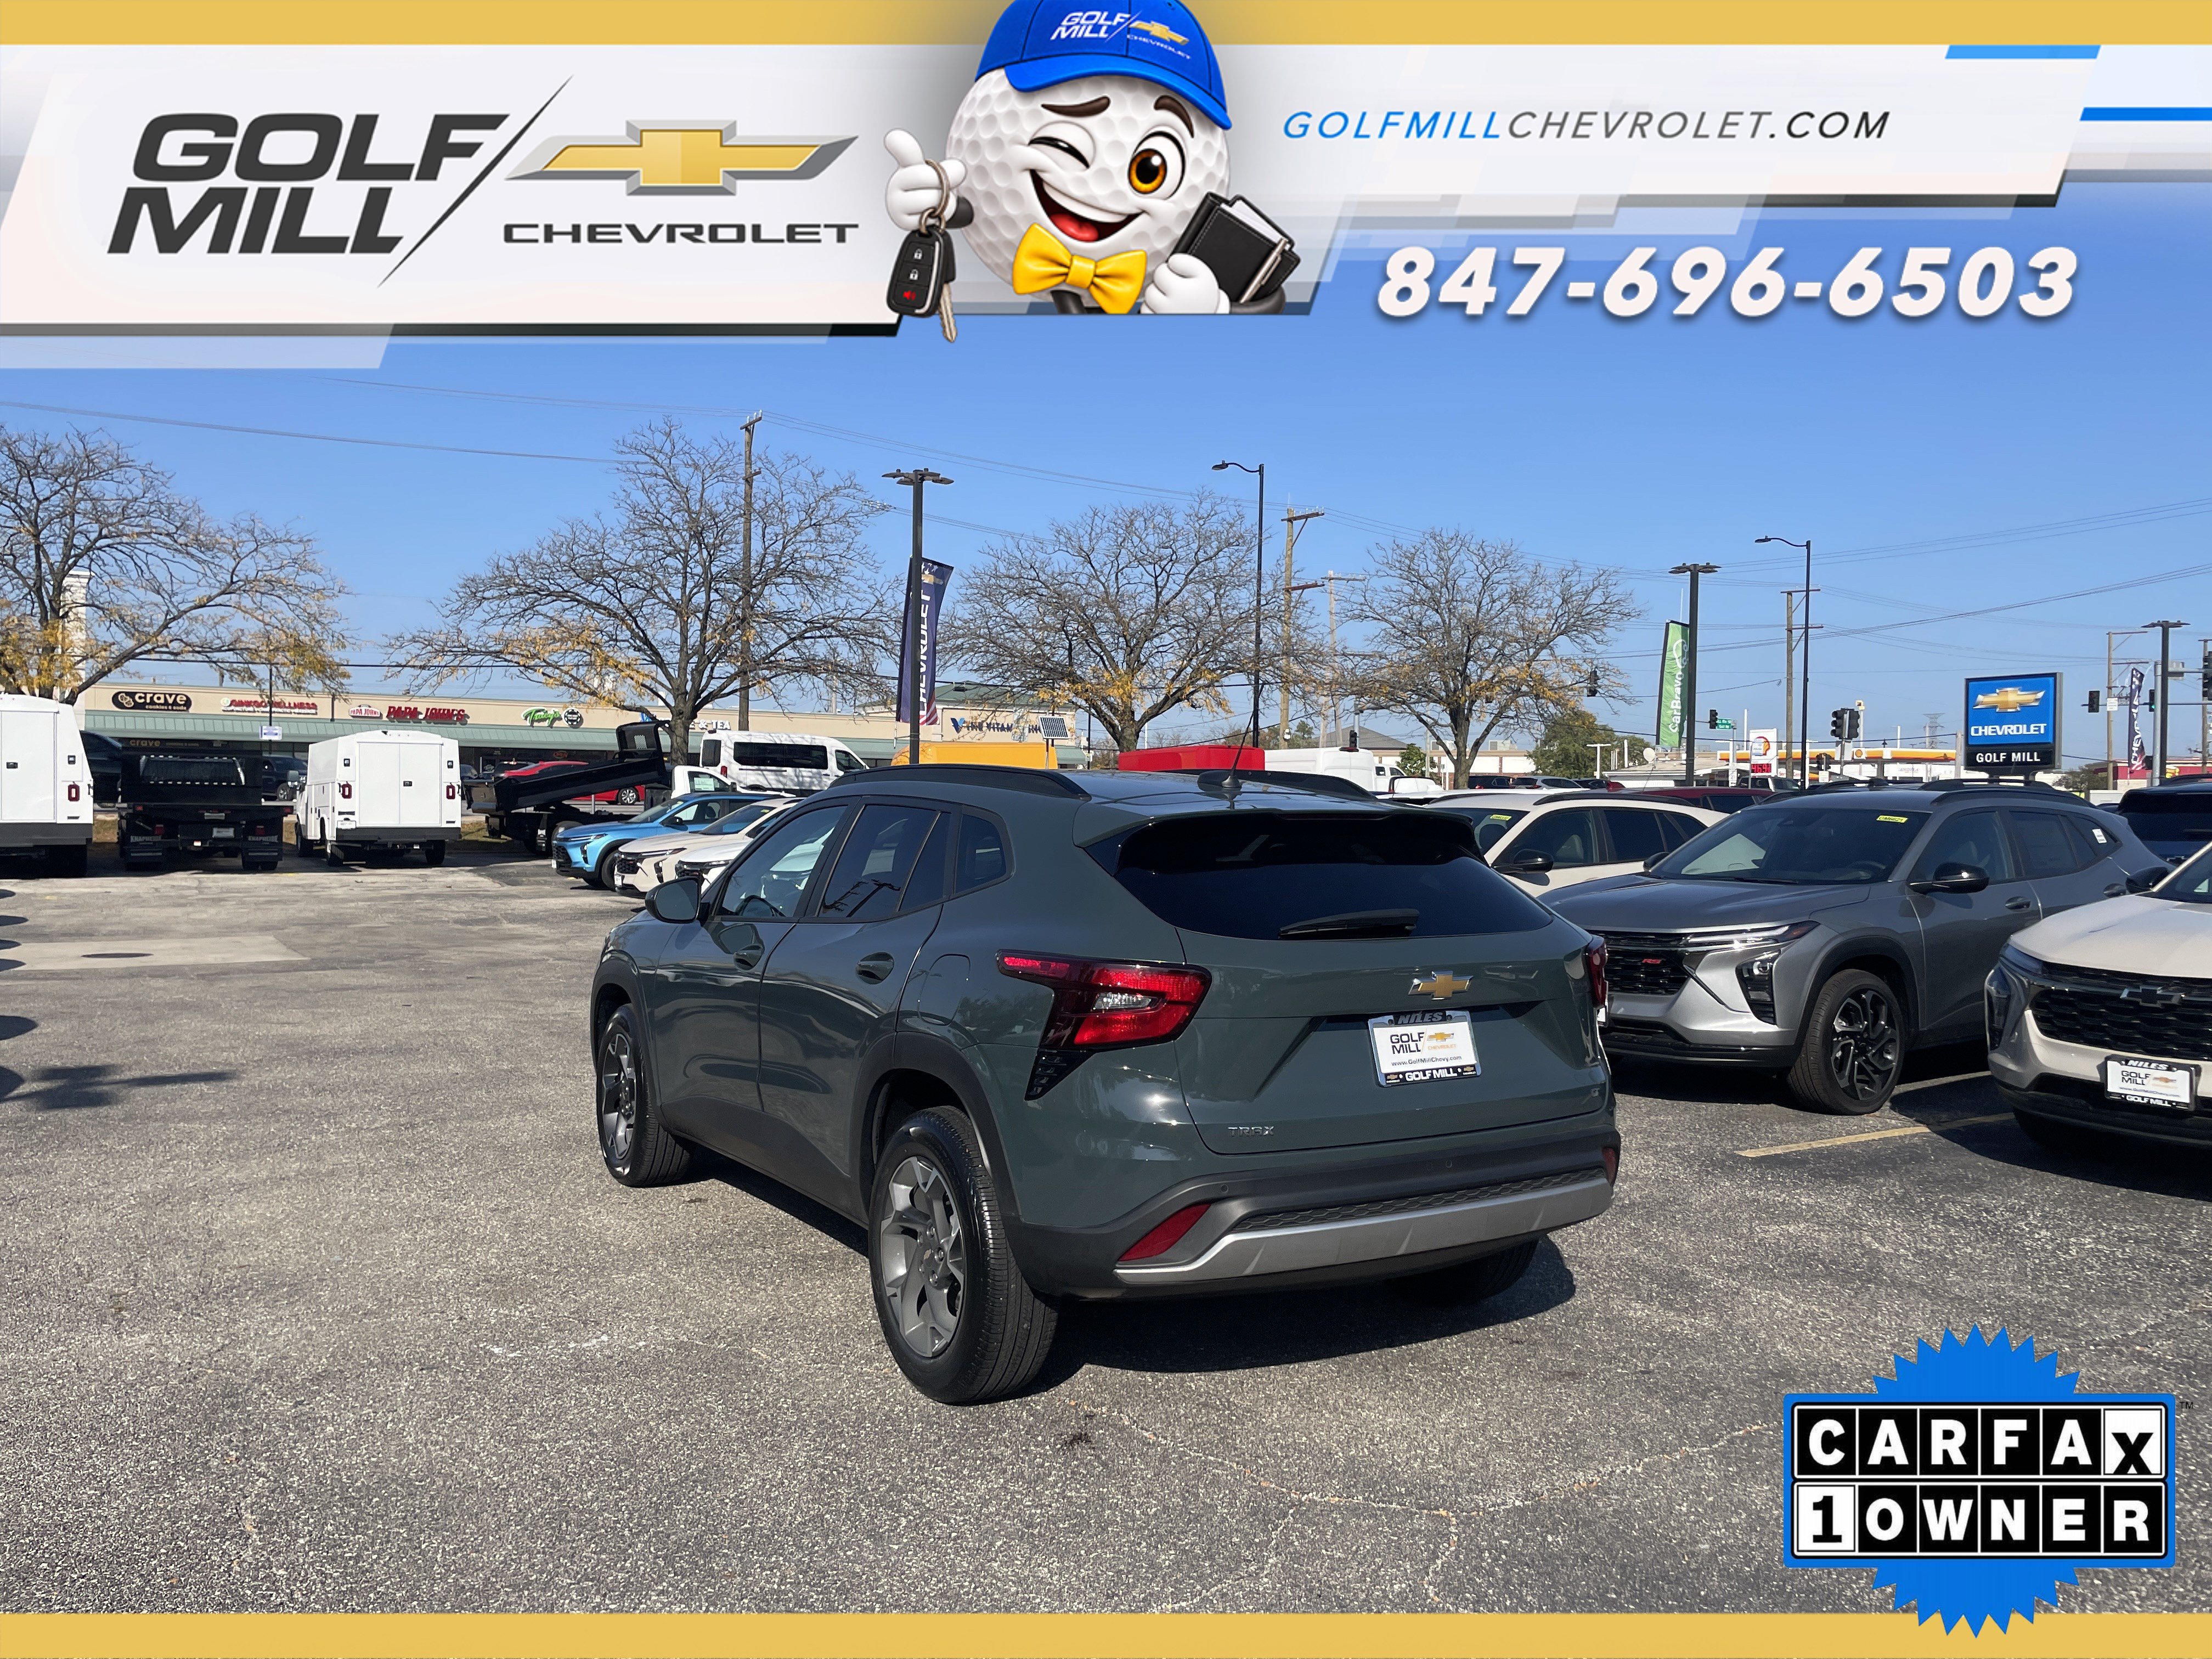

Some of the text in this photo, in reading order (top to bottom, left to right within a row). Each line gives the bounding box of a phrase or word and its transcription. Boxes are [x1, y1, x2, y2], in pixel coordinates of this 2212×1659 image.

[135, 693, 187, 704] crave
[1669, 672, 1684, 733] CarBravo
[386, 706, 419, 719] PAPA
[710, 720, 731, 730] TEA
[1971, 723, 2047, 736] CHEVROLET
[1976, 752, 2041, 763] GOLF MILL
[1398, 1012, 1444, 1024] NILES
[1390, 1032, 1425, 1044] GOLF
[1392, 1043, 1421, 1054] MILL
[1391, 1056, 1462, 1066] www.GolfMillChevy.com
[2128, 1060, 2169, 1070] NILES
[1405, 1068, 1458, 1081] GOLF MILL
[2121, 1070, 2151, 1080] GOLF
[2121, 1077, 2146, 1086] MILL
[2126, 1095, 2172, 1107] GOLF MILL
[1228, 1126, 1274, 1136] TRAX
